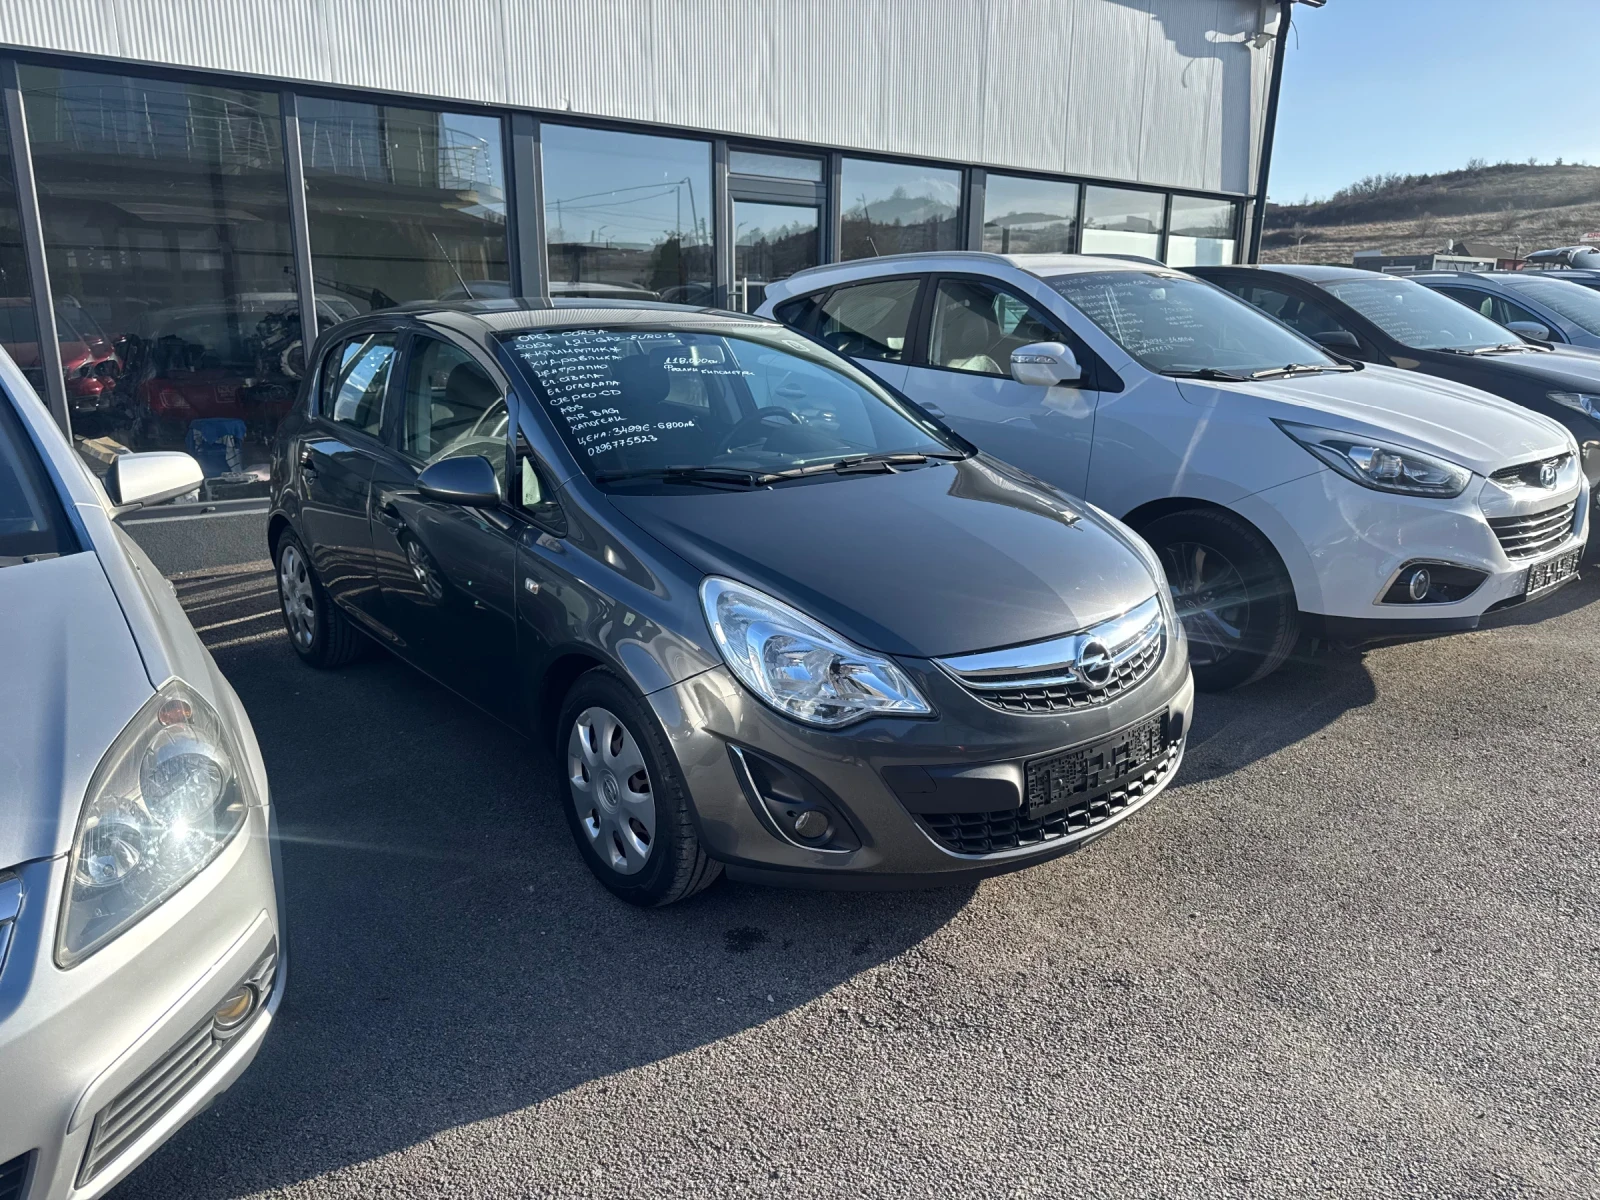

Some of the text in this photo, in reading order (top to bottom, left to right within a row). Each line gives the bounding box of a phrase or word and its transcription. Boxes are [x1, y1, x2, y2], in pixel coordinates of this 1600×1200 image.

[517, 329, 608, 342] OPEL CORSA
[560, 404, 584, 415] ABS
[589, 407, 620, 417] BAG
[587, 434, 658, 457] 0896775523
